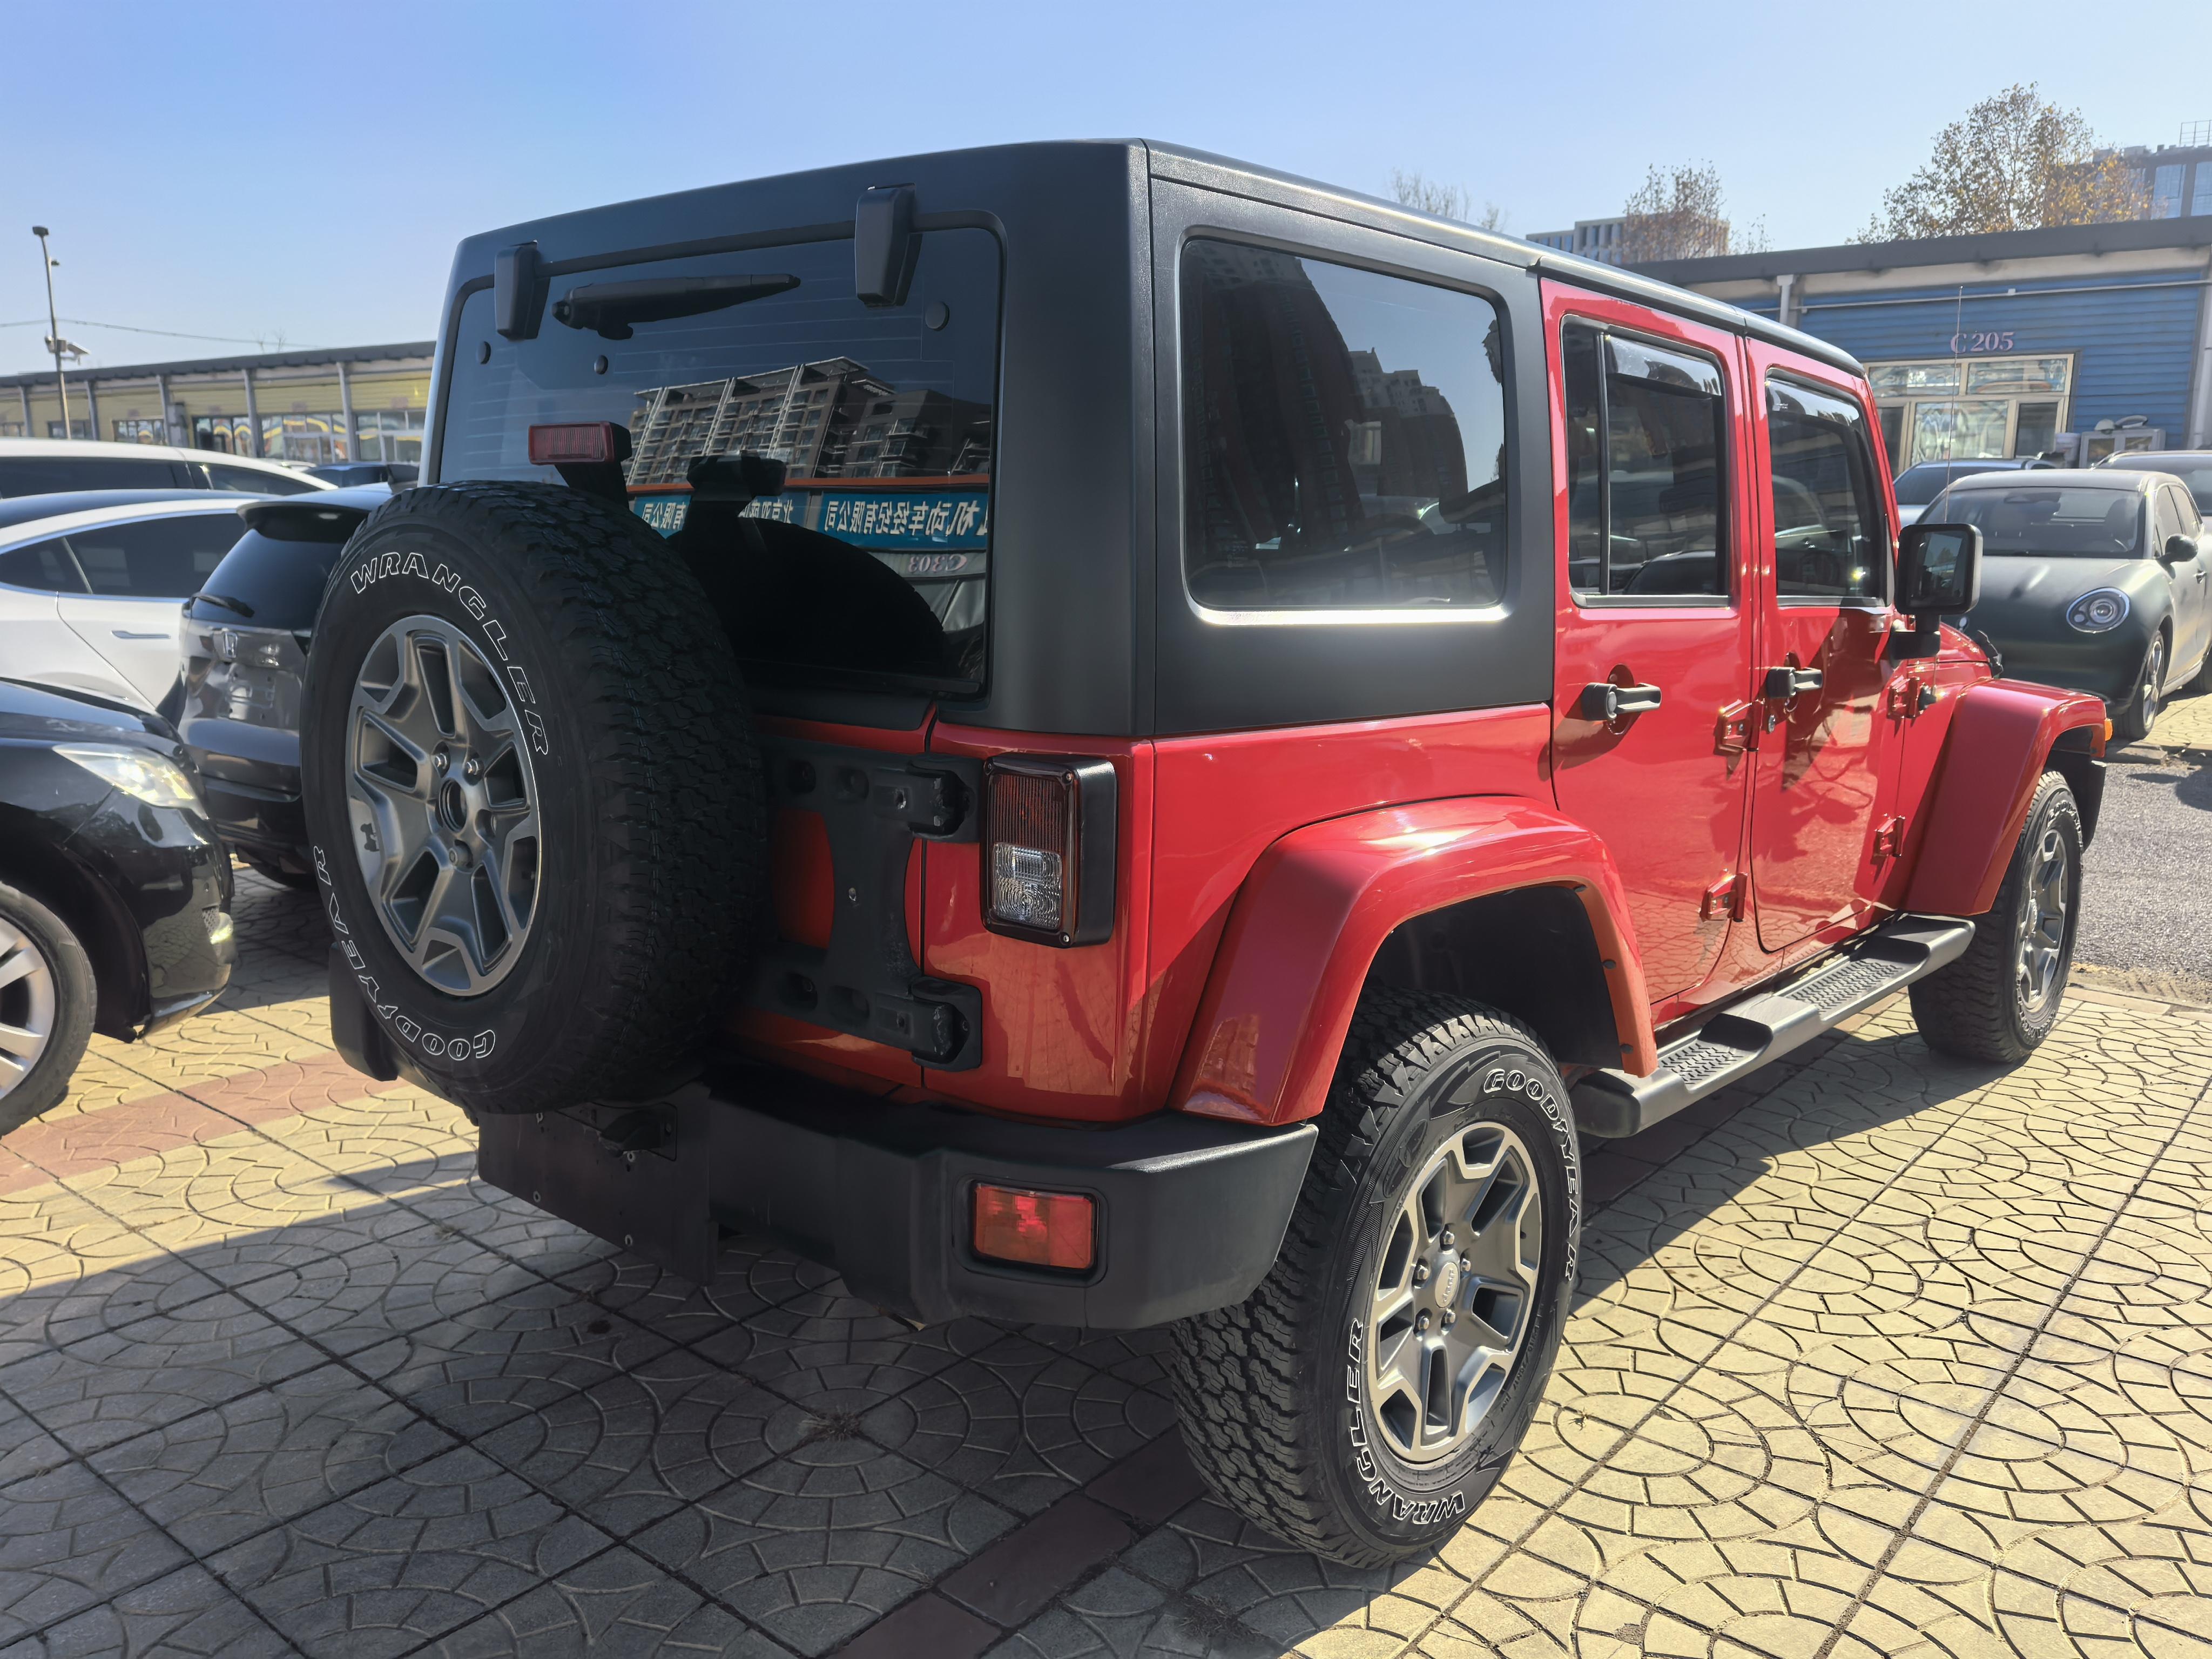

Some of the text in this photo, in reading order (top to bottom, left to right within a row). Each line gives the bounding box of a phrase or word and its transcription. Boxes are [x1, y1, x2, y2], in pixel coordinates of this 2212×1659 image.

[350, 551, 549, 756] WRANGLER
[313, 846, 496, 1061] GOODYEAR
[1483, 1068, 1579, 1282] GOODYEAR
[1346, 1317, 1466, 1525] WRANGLER
